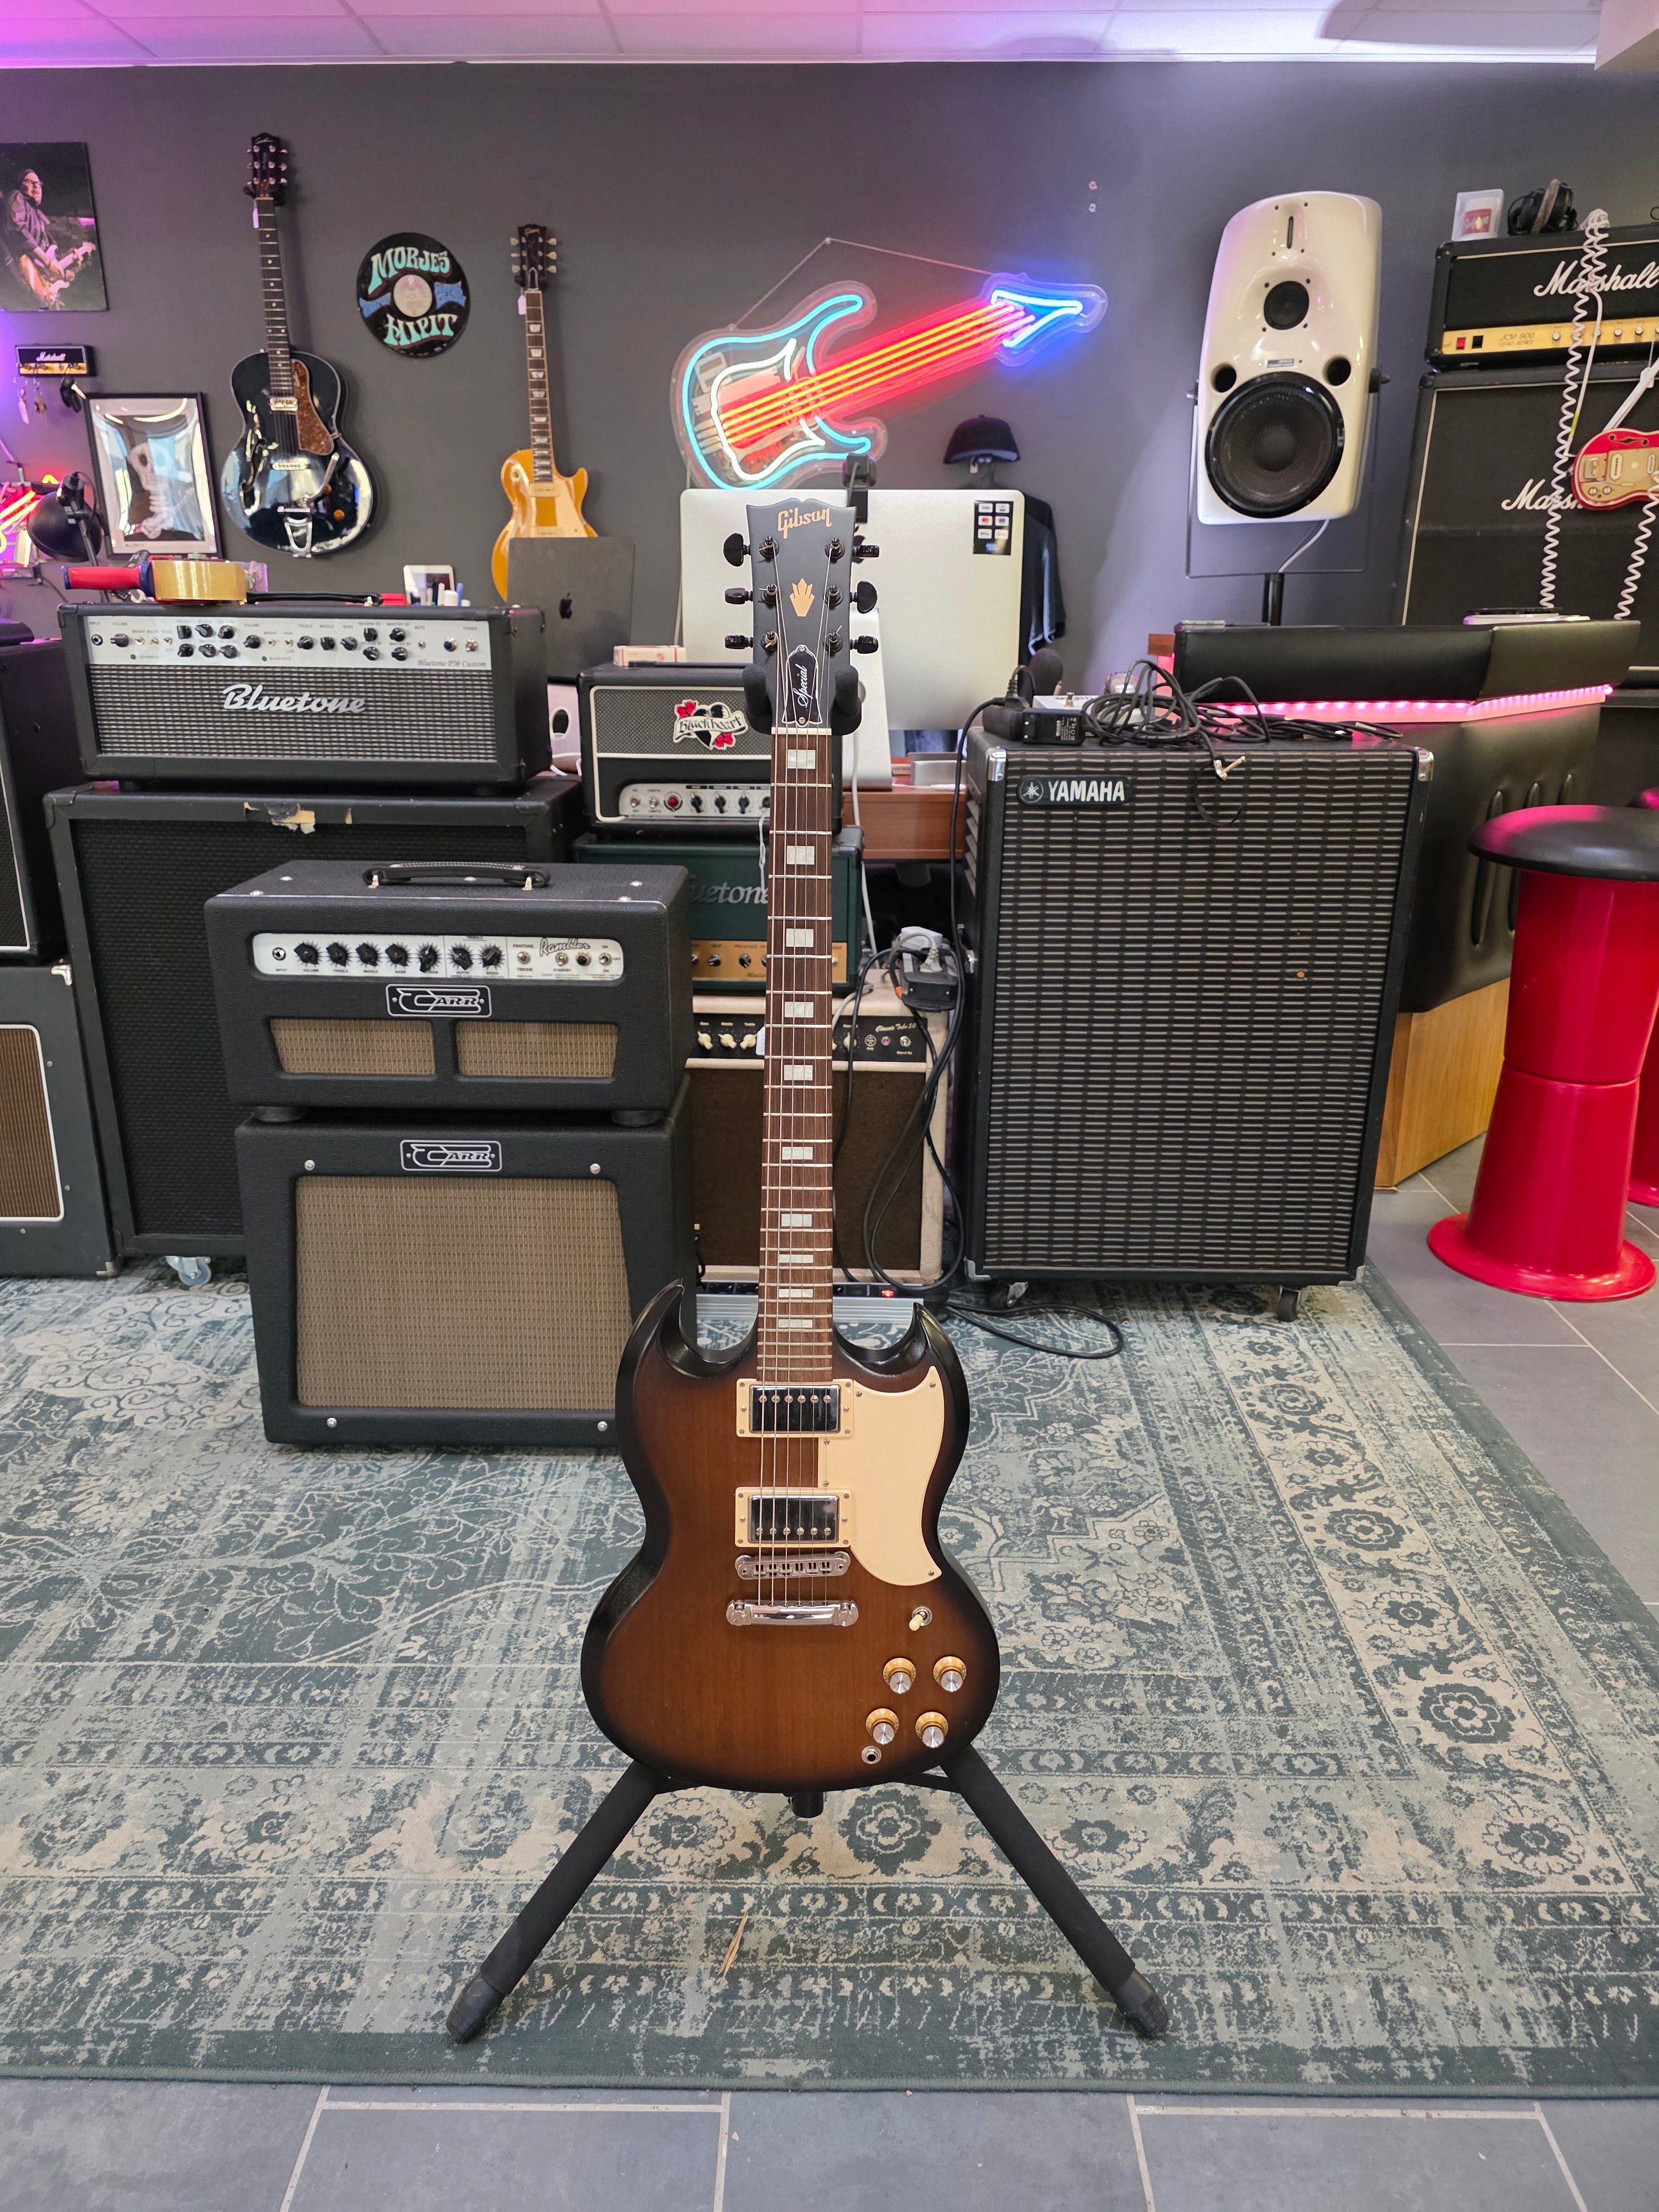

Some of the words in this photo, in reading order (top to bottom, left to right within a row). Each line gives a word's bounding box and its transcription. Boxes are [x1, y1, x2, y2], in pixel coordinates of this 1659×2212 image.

[368, 247, 450, 295] MORJES
[383, 314, 458, 346] HIPIT
[778, 507, 832, 539] Gibson
[223, 684, 365, 713] Bluetone
[793, 663, 813, 708] Special
[1048, 780, 1125, 802] YAMAHA
[540, 937, 591, 957] Rambler
